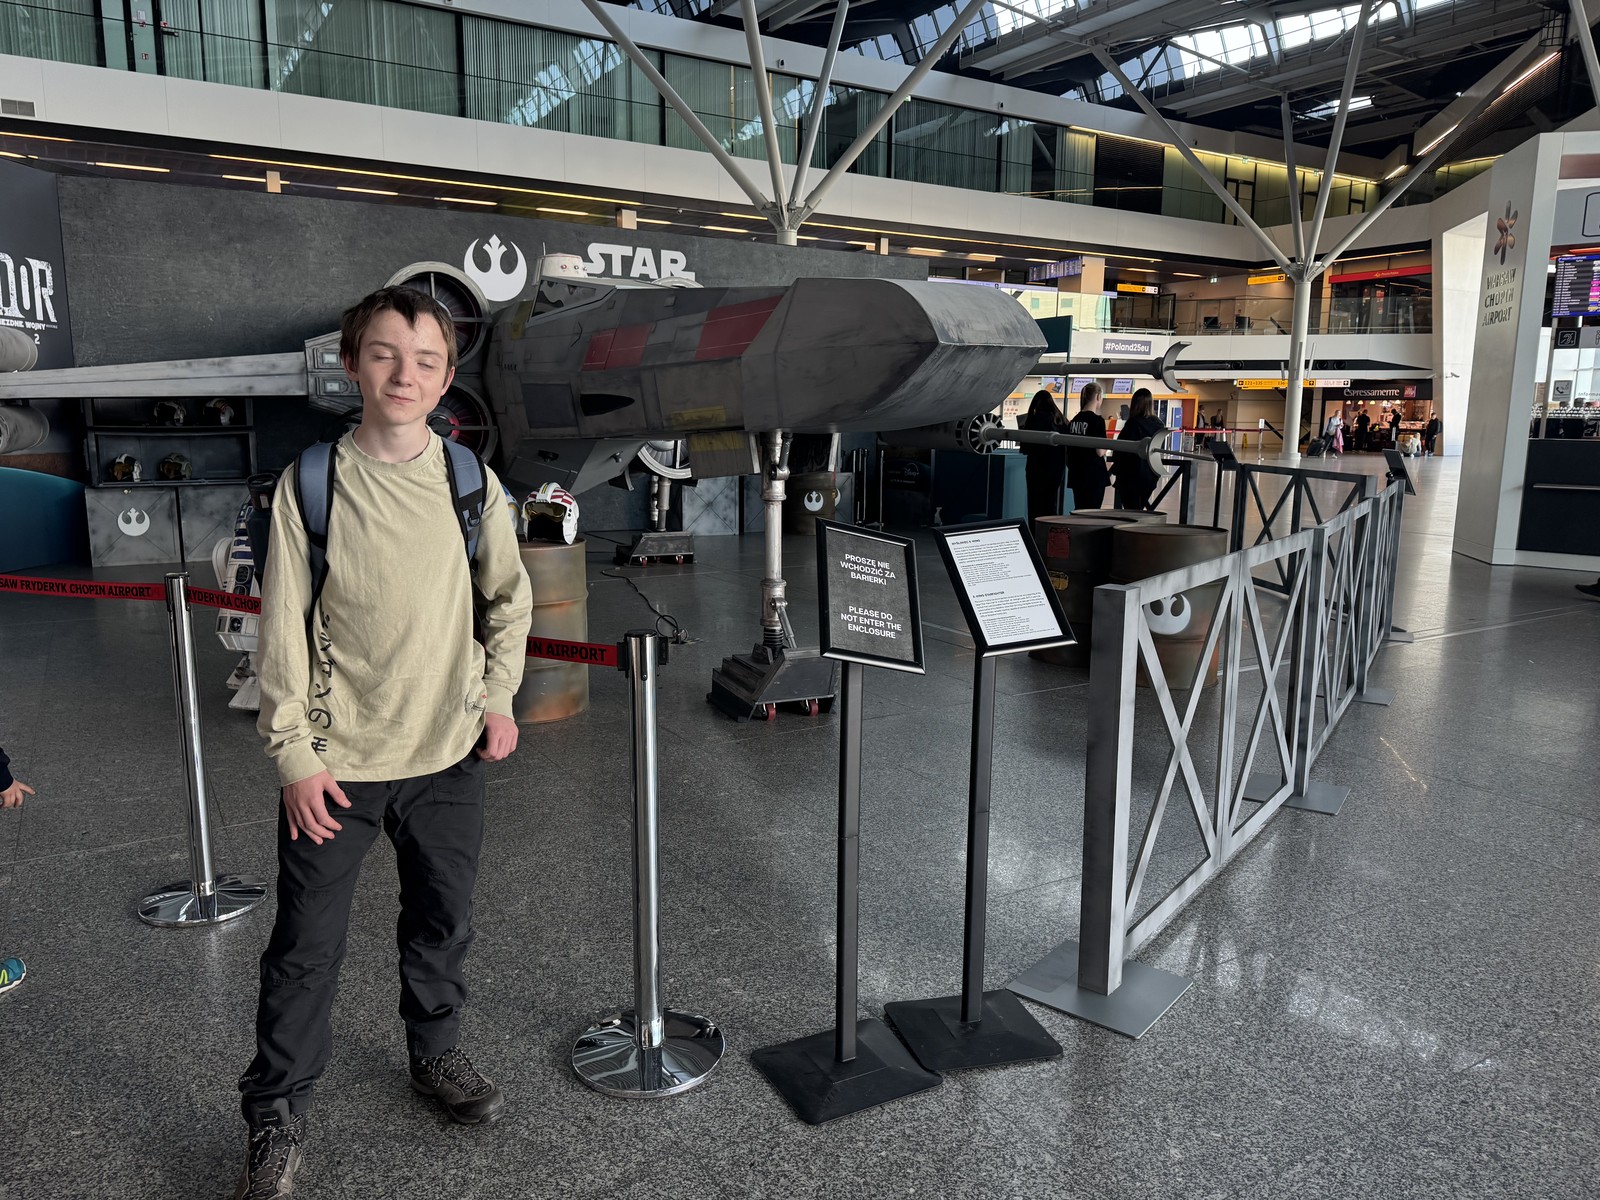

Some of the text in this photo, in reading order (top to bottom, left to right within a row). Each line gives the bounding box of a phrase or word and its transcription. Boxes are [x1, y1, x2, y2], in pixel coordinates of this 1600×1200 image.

[583, 242, 696, 282] STAR
[1487, 268, 1516, 290] WARSAW
[1485, 288, 1514, 308] CHOPIN
[0, 318, 24, 328] IEZDNE
[25, 321, 46, 331] WOJNY
[1482, 307, 1512, 326] AIRPORT
[34, 333, 40, 345] 2
[1105, 342, 1150, 352] #Poland25eu
[840, 561, 896, 579] WCHODZIĆ ZA
[845, 553, 890, 569] PROSZĘ NIE
[0, 578, 152, 597] SAW FRYDERYK CHOPIN AIRPORT
[850, 572, 887, 585] BARIERKI
[187, 588, 260, 611] RYDERYKA CHOP
[849, 605, 893, 620] PLEASE DO
[841, 613, 902, 631] NOT ENTER THE
[848, 623, 896, 639] ENCLOSURE
[546, 643, 607, 661] AIRPORT
